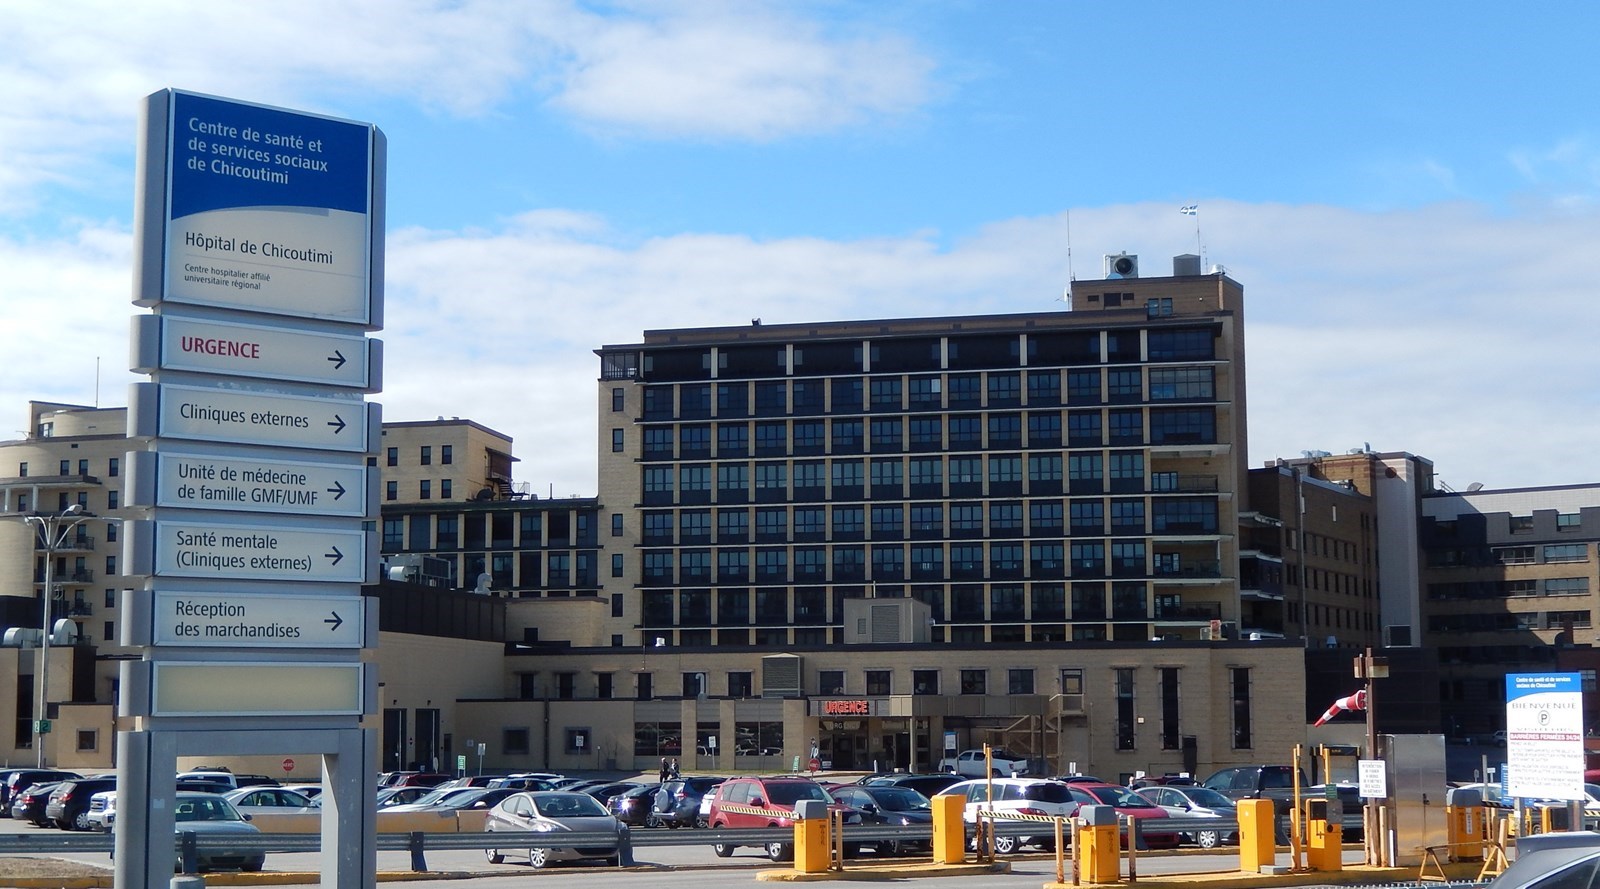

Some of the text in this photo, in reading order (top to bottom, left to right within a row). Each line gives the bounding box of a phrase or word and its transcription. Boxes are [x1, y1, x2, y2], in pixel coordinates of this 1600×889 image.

[189, 118, 322, 152] Centre de santé et
[188, 137, 328, 172] de services sociaux
[187, 156, 289, 184] de Chicoutimi
[186, 232, 333, 264] Hôpital de Chicoutimi
[184, 263, 271, 281] Centre hospitalier affilié
[184, 275, 261, 291] universitaire régional
[182, 336, 260, 359] URGENCE
[180, 403, 309, 428] Cliniques externes
[178, 464, 306, 485] Unité de médecine
[178, 484, 318, 506] de famille GMF/UMF
[176, 531, 278, 549] Santé mentale
[176, 550, 312, 572] (Cliniques externes)
[176, 601, 245, 619] Réception
[175, 622, 300, 638] des marchandises
[825, 701, 868, 713] URGENCE
[1541, 714, 1547, 722] P
